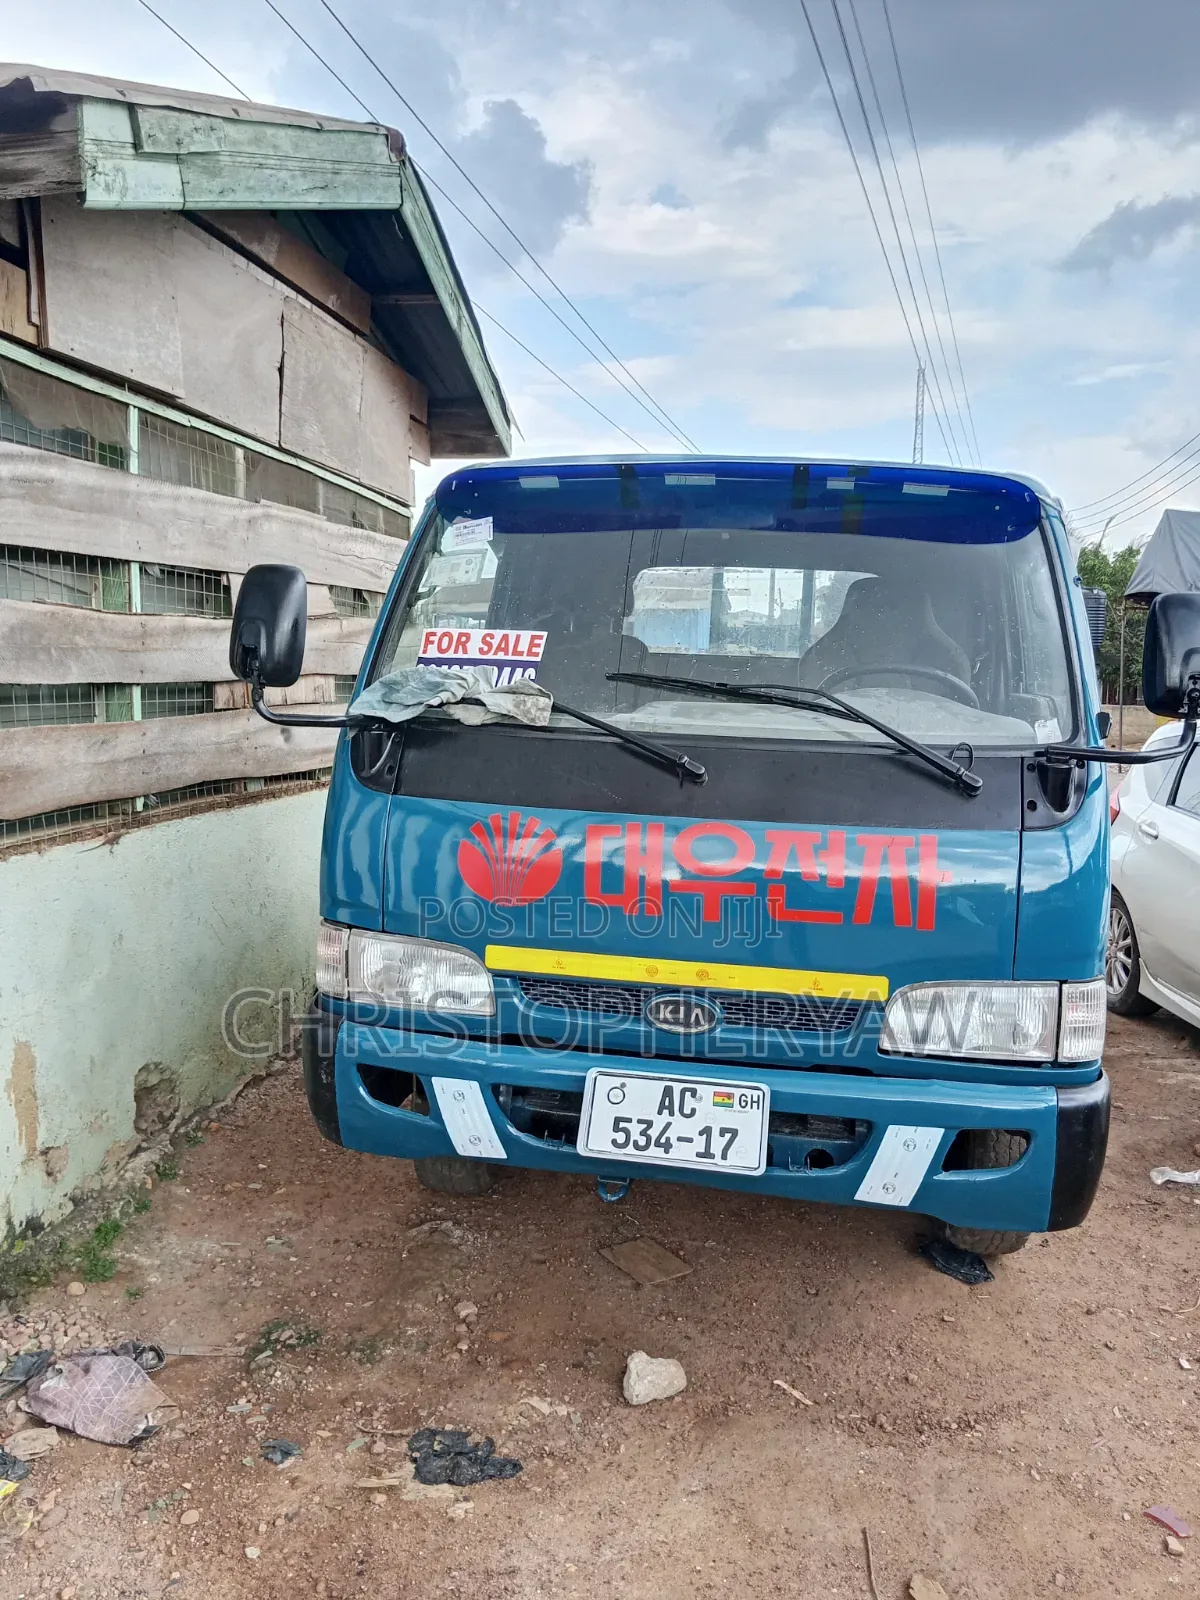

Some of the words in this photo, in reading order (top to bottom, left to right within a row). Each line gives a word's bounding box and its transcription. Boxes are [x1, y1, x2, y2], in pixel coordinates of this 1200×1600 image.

[422, 631, 471, 655] FOR
[478, 634, 545, 657] SALE
[585, 822, 953, 931] 대우전자
[659, 1004, 705, 1025] KIA
[657, 1085, 698, 1118] AC
[738, 1093, 761, 1110] GH
[611, 1116, 739, 1160] 534-17
